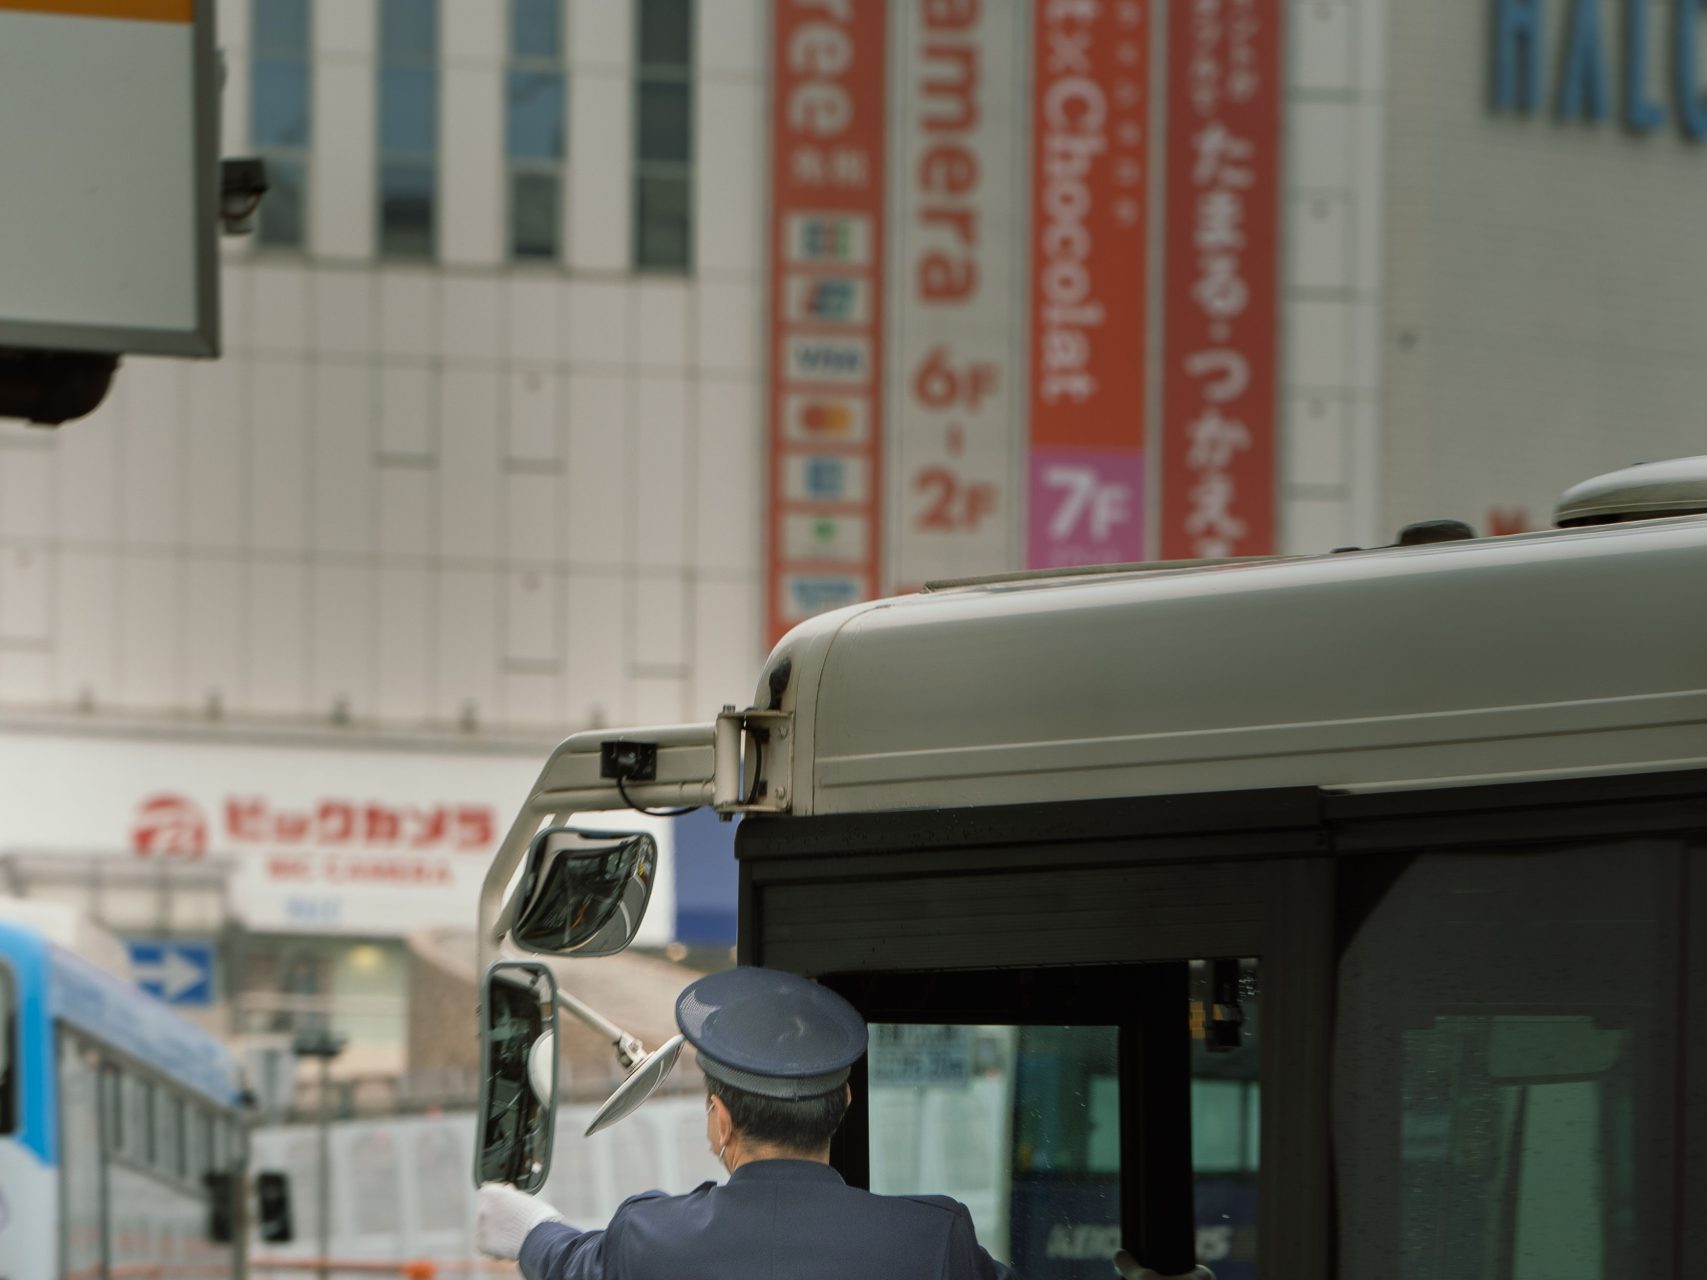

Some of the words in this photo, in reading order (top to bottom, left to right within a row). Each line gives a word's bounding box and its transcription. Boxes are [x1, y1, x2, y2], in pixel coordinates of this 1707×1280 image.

[912, 345, 1000, 414] 6F
[911, 463, 1000, 533] 2F
[1043, 465, 1132, 543] 7F
[222, 796, 495, 850] ビックカメラ
